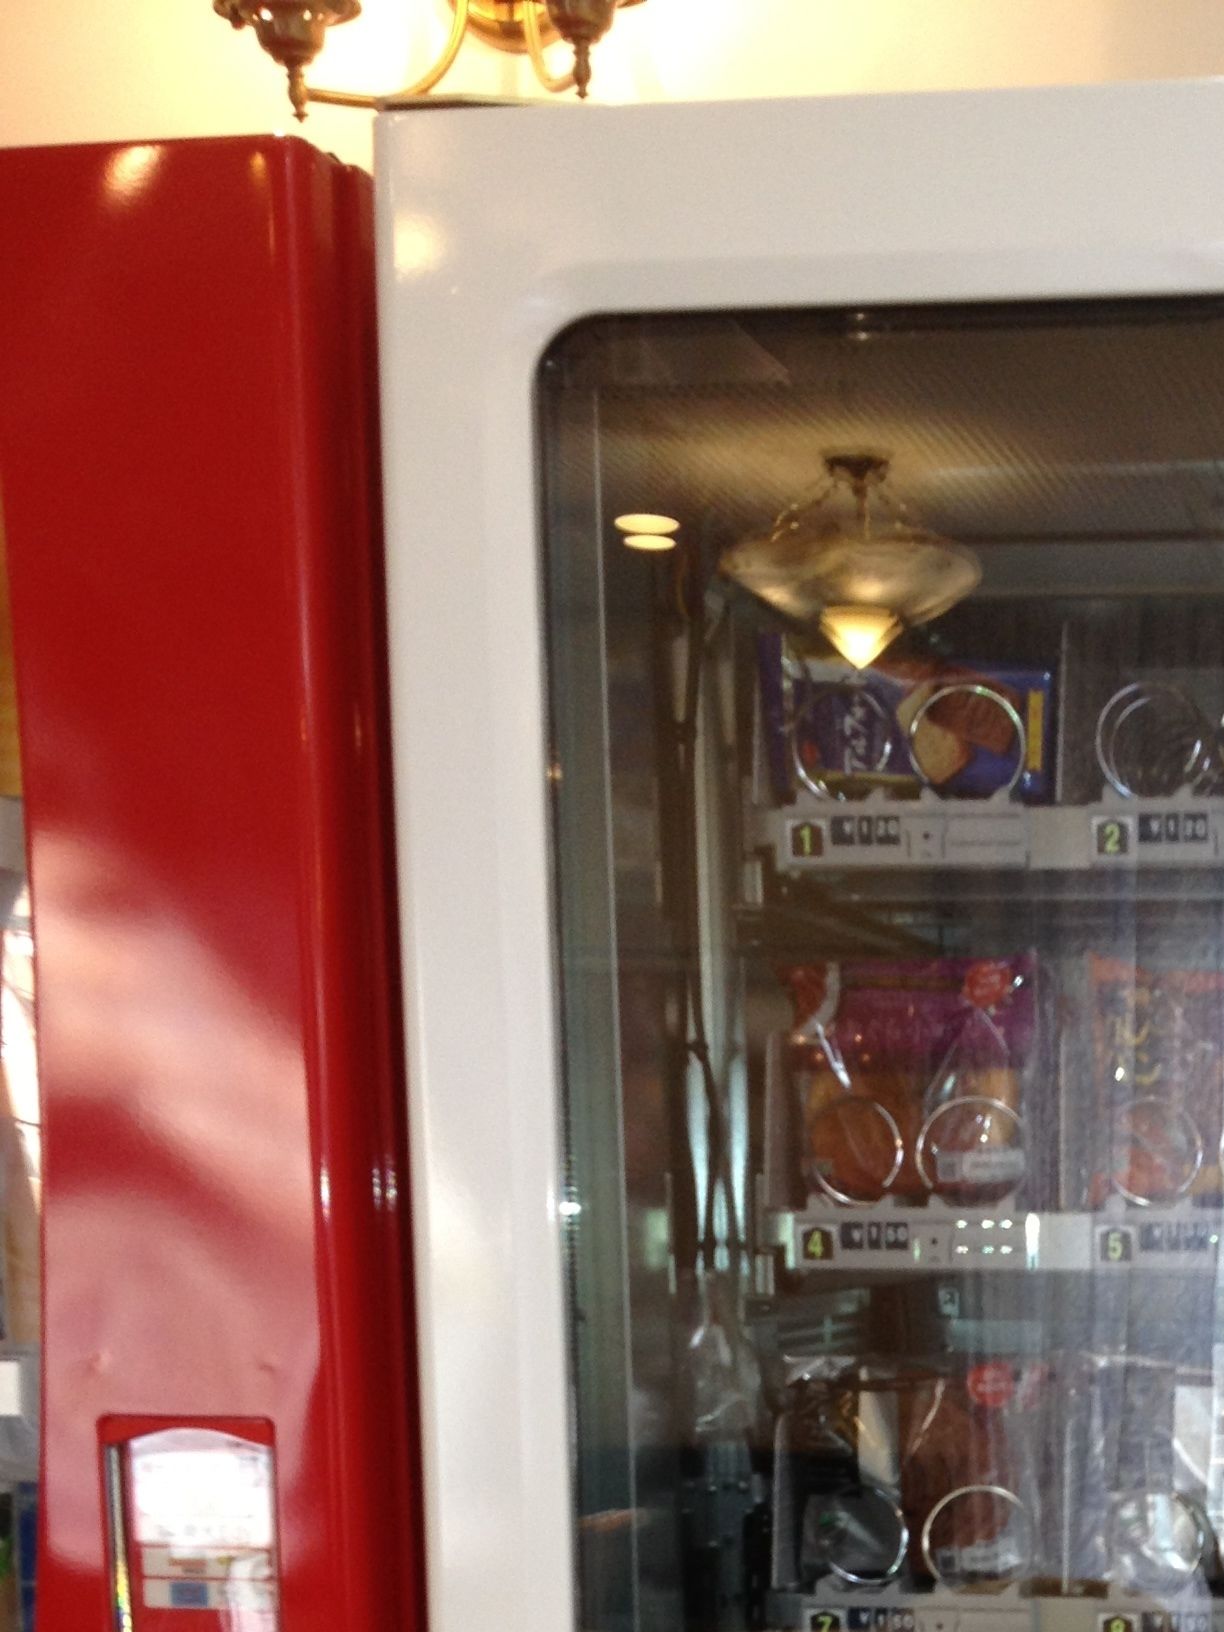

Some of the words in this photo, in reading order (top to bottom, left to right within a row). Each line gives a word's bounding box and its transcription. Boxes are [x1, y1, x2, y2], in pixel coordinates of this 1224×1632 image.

[800, 821, 813, 856] 1
[1103, 822, 1121, 855] 2
[806, 1229, 824, 1260] 4
[1106, 1236, 1123, 1259] 5
